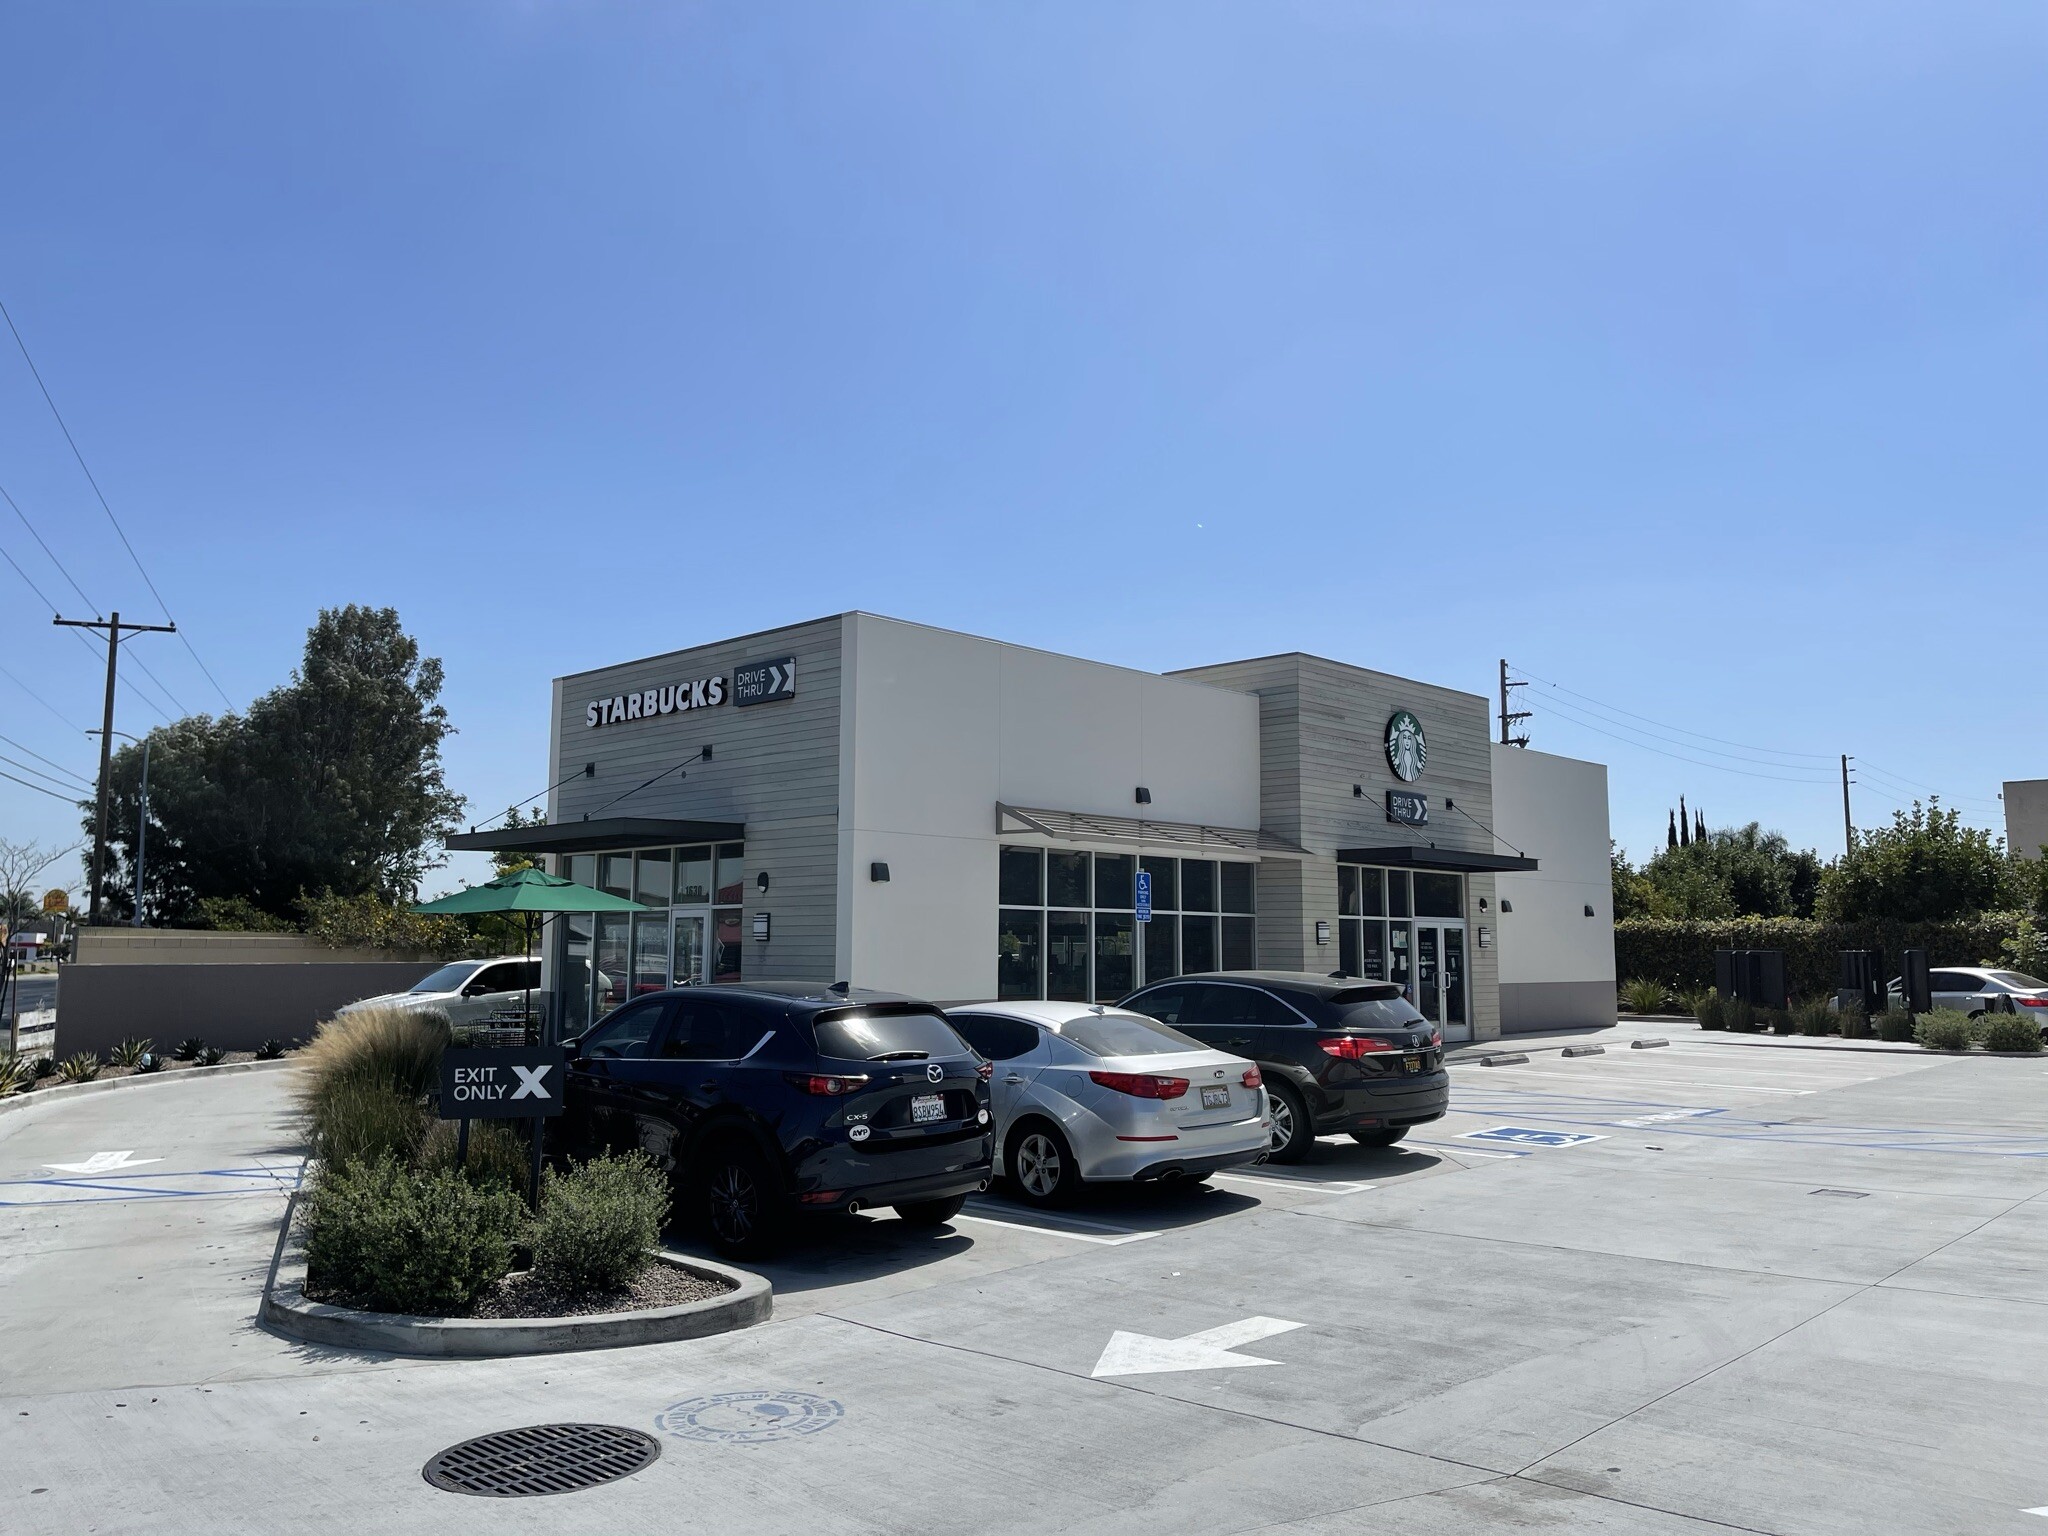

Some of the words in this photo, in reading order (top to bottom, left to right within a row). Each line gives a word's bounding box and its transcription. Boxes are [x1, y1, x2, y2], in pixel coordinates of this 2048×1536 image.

[738, 669, 766, 686] DRIVE
[738, 683, 764, 699] THRU
[586, 676, 724, 727] STARBUCKS
[1392, 796, 1412, 808] DRIVE
[1393, 807, 1412, 819] THRU
[454, 1067, 498, 1083] EXIT
[453, 1084, 507, 1101] ONLY
[846, 1113, 868, 1121] CX-5
